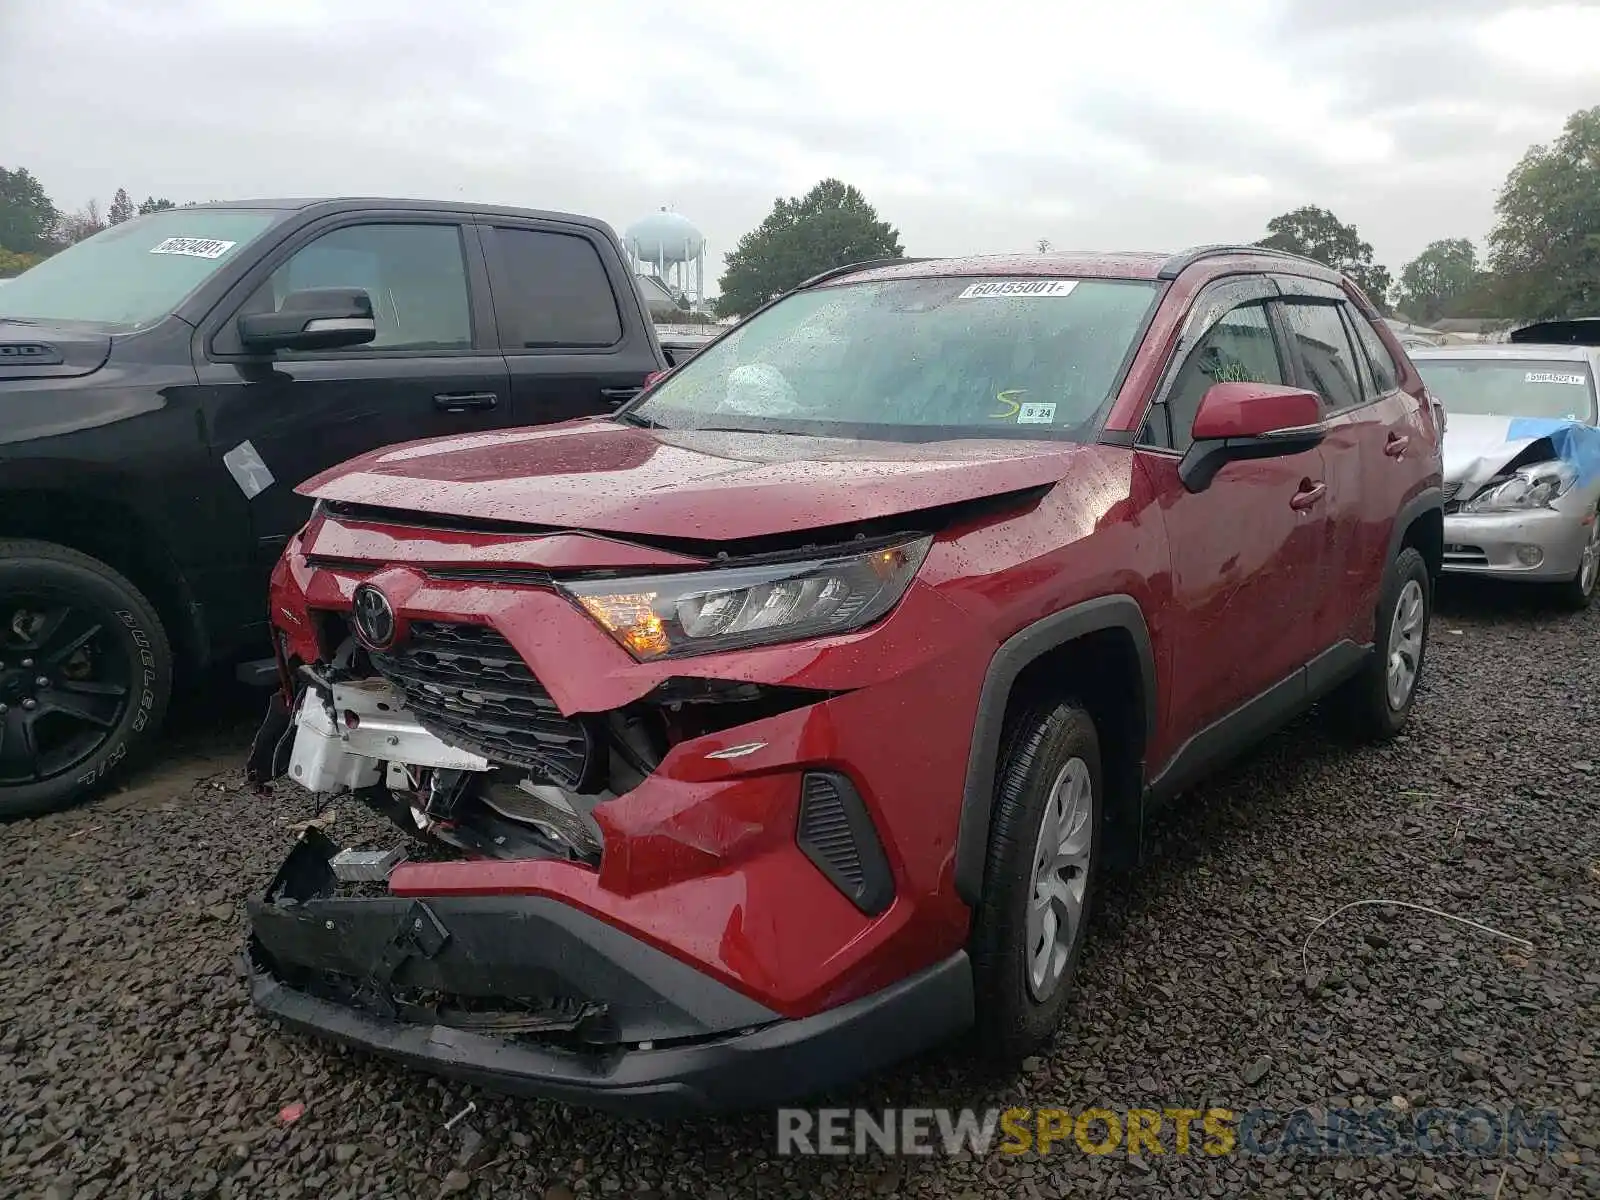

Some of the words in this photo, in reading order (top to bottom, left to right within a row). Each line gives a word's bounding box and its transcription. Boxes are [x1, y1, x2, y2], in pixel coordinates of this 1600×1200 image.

[1026, 408, 1034, 417] 9
[1037, 408, 1051, 418] 24
[114, 610, 156, 733] DUELER
